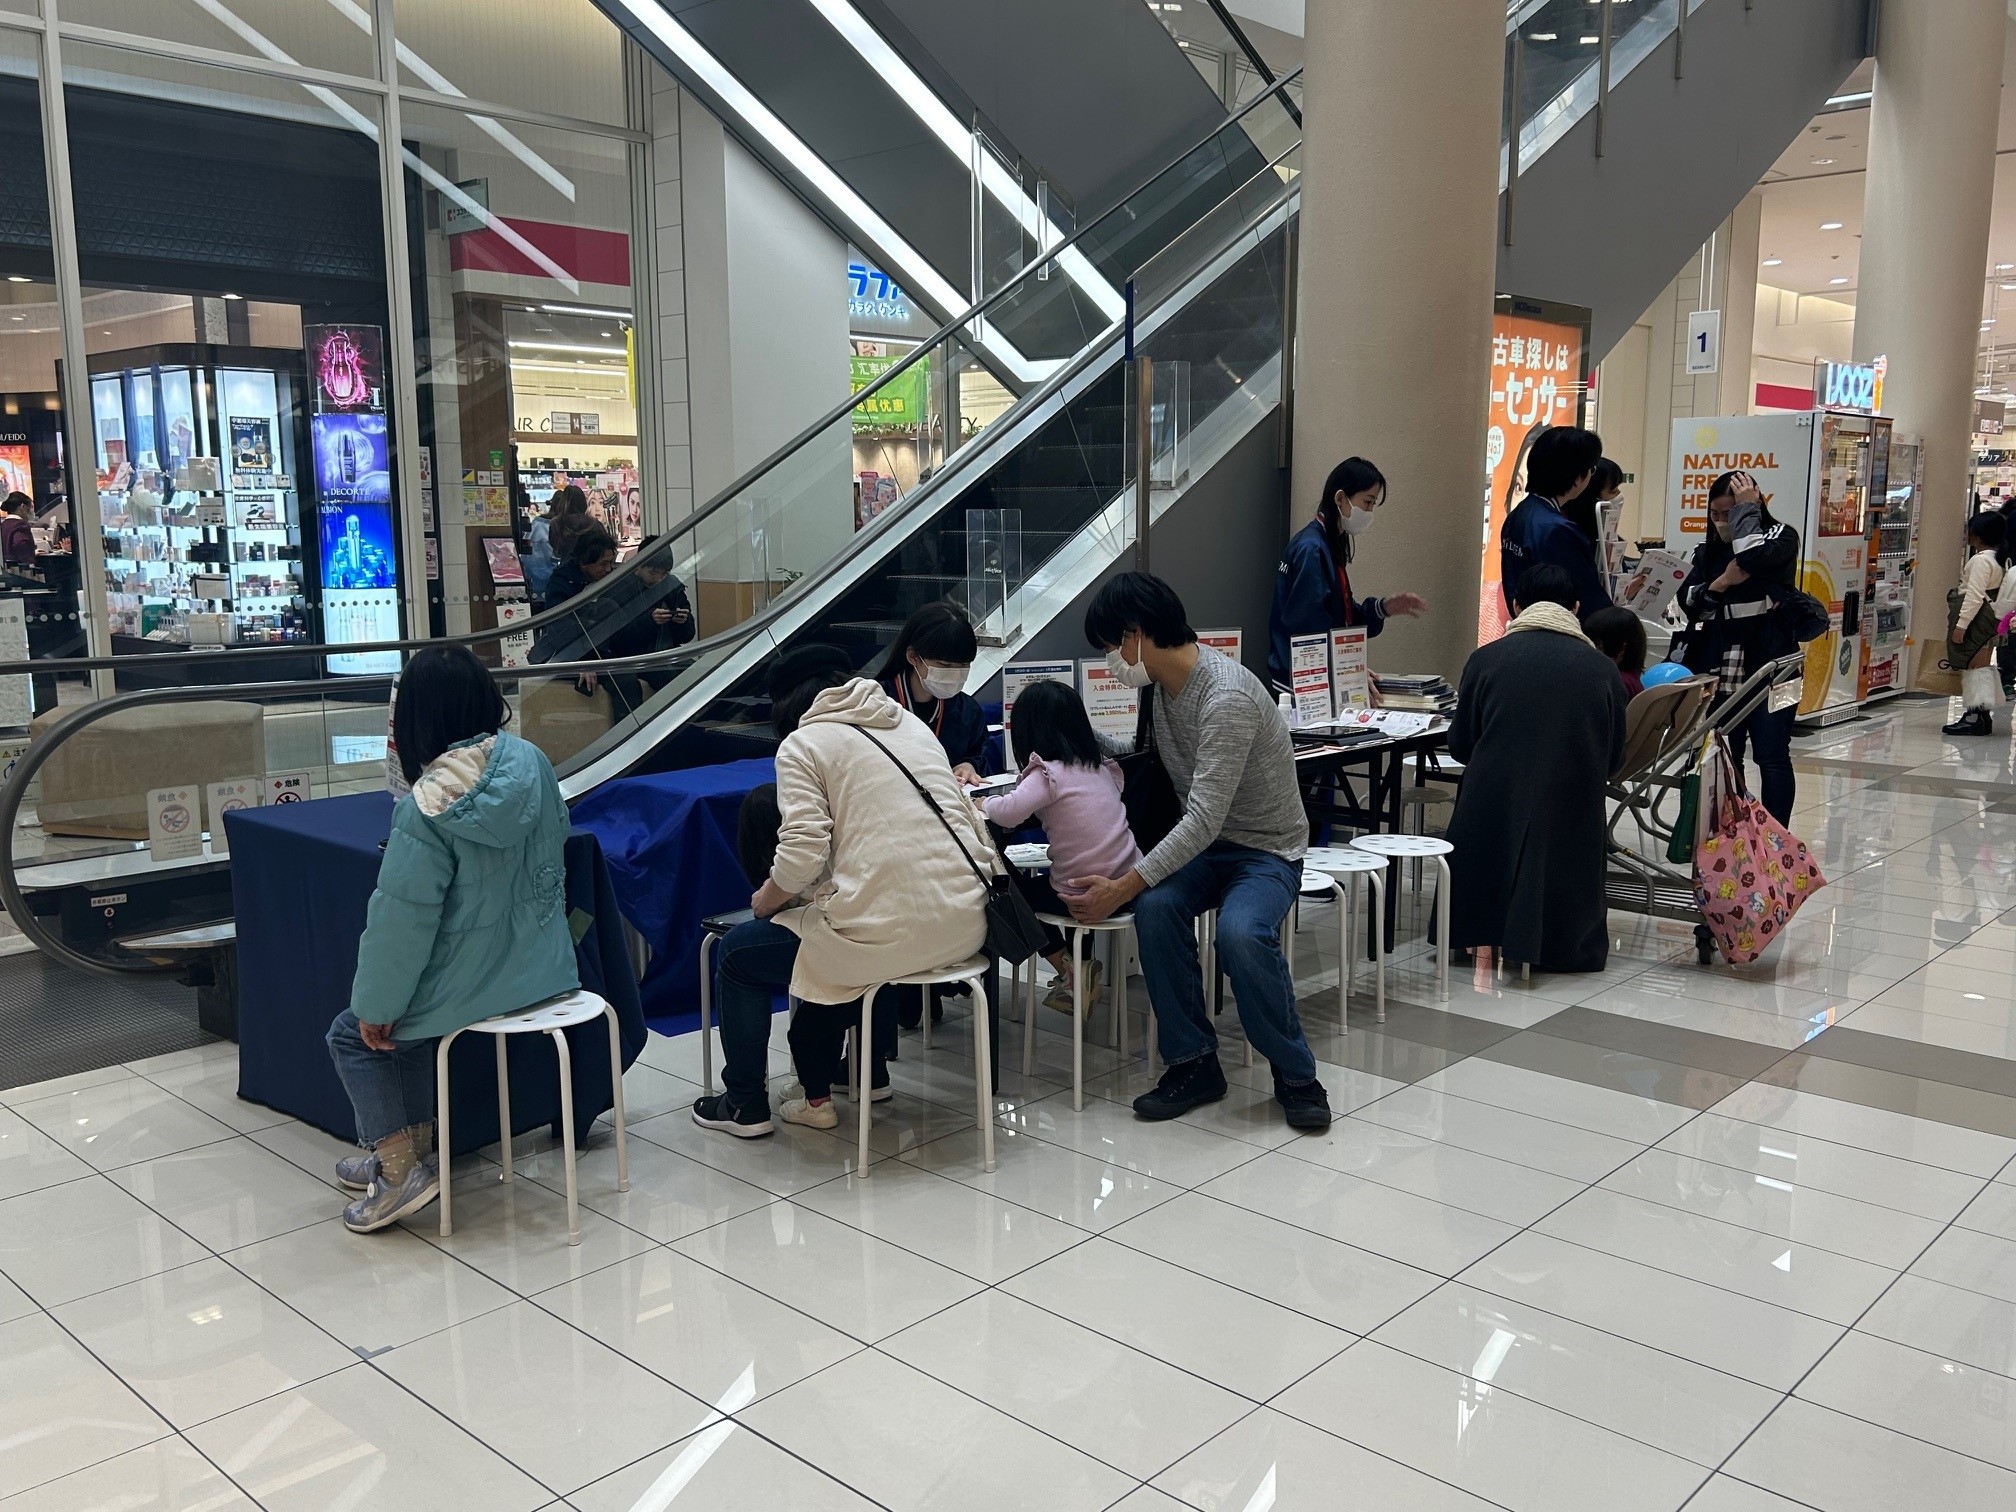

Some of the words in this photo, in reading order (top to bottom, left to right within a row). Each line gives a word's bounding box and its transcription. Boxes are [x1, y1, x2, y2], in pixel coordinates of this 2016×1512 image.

[1697, 332, 1706, 352] 1
[1493, 333, 1568, 371] 古車探しは
[1490, 372, 1567, 426] ーセンサー
[514, 417, 534, 431] IR
[540, 417, 553, 432] C
[1683, 453, 1779, 470] NATURAL
[1682, 474, 1719, 490] FRE
[507, 632, 528, 642] FREE
[1092, 684, 1137, 692] 入会特典の
[1128, 704, 1138, 714] 無
[285, 778, 301, 788] 危険
